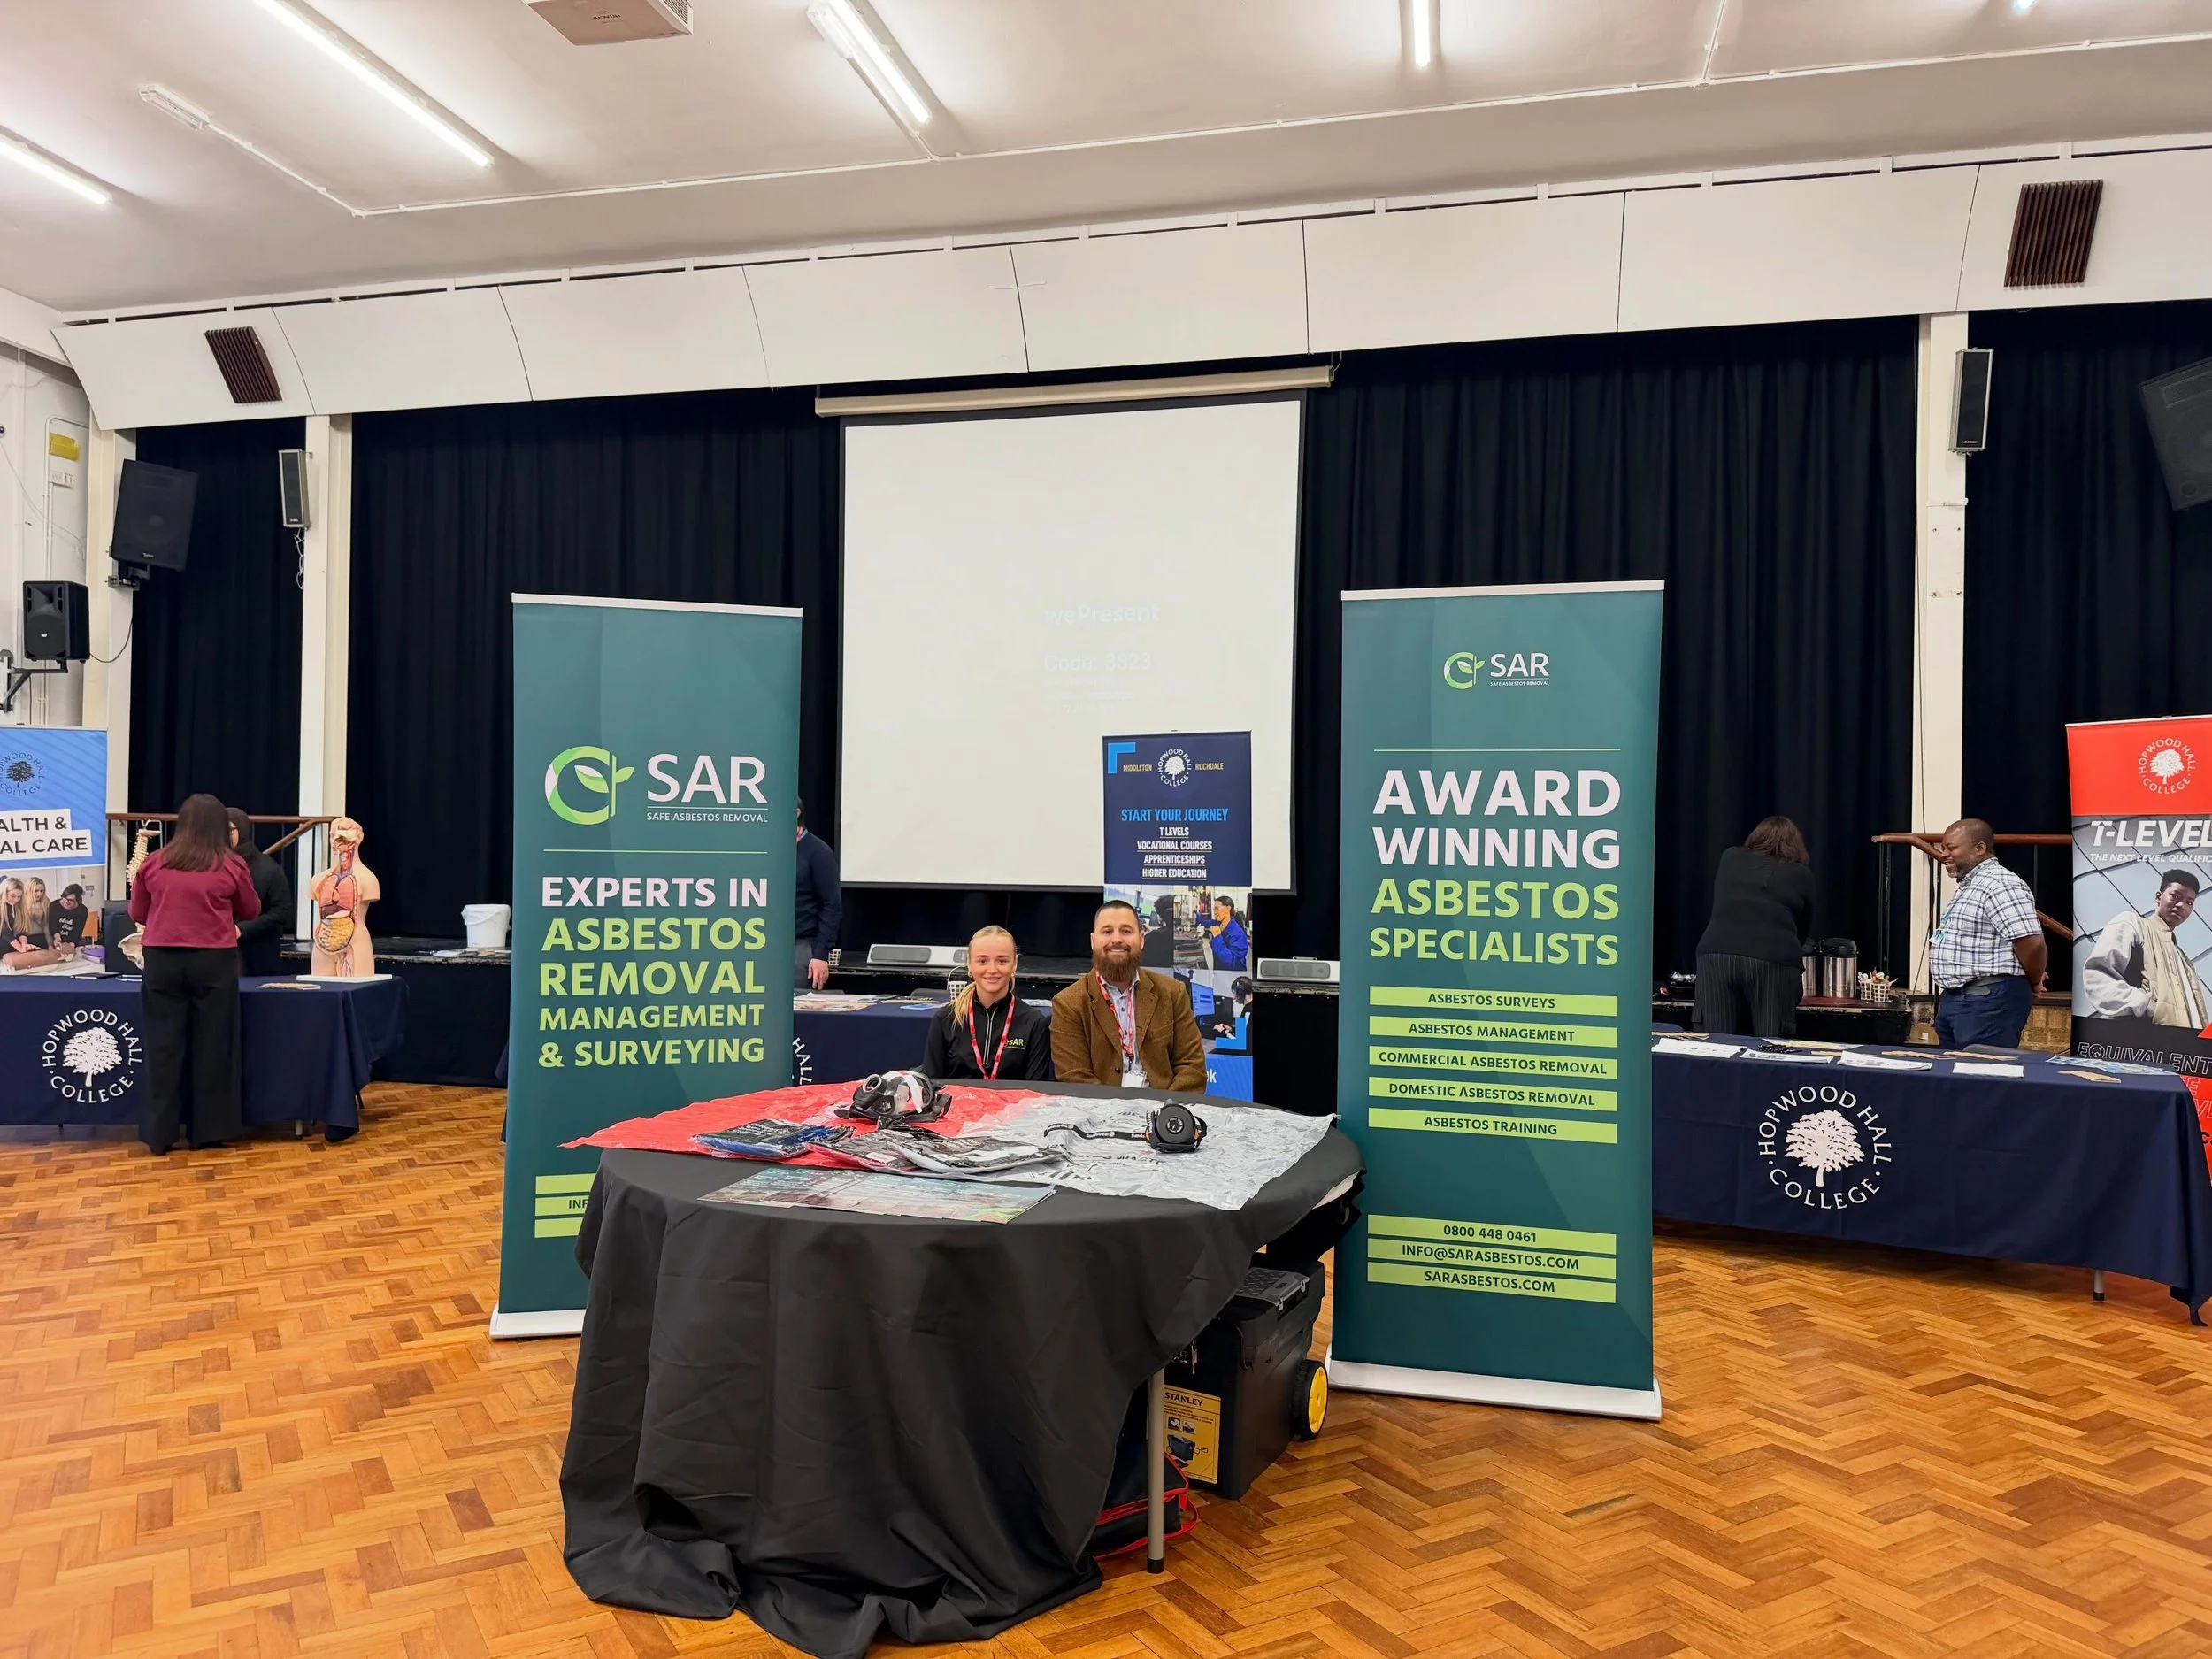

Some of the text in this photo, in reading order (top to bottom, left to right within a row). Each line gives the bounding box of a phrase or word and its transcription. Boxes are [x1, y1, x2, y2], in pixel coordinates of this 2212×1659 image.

[1044, 604, 1162, 625] wePresent
[1490, 652, 1550, 678] SAR
[1123, 762, 1225, 772] MIDDLETON ROCHDALE
[1157, 748, 1193, 773] HOPWOOD HALL
[2138, 738, 2196, 774] HOPWOOD HALL
[1, 783, 42, 796] COLLEGE
[647, 753, 768, 804] SAR
[1160, 772, 1189, 787] COLLEGE
[2142, 777, 2192, 795] COLLEGE
[1372, 770, 1621, 817] AWARD
[55, 816, 67, 830] &
[647, 812, 768, 823] SAFE ASBESTOS REMOVAL
[1121, 808, 1229, 821] START YOUR JOURNEY
[1159, 826, 1189, 836] T LEVELS
[32, 837, 88, 853] CARE
[1137, 841, 1213, 850] VOCATIONAL COURSES
[1372, 826, 1620, 870] WINNING
[1143, 855, 1206, 864] APPRENTICESHIPS
[2090, 853, 2109, 862] THE
[2109, 853, 2137, 862] NEXT
[2137, 854, 2166, 863] LEVEL
[1142, 868, 1207, 879] HIGHER EDUCATION
[541, 876, 768, 907] EXPERTS IN
[1371, 879, 1619, 921] ASBESTOS
[541, 917, 767, 952] ASBESTOS
[1370, 926, 1618, 966] SPECIALISTS
[539, 960, 765, 997] REMOVAL
[1428, 993, 1555, 1009] ASBESTOS SURVEYS
[538, 1003, 765, 1031] MANAGEMENT
[42, 1009, 142, 1068] HOPWOOD HALL
[1409, 1023, 1575, 1041] ASBESTOS MANAGEMENT
[538, 1037, 764, 1069] & SURVEYING
[792, 1037, 813, 1086] HALL
[1379, 1051, 1607, 1075] COMMERCIAL ASBESTOS REMOVAL
[50, 1075, 134, 1103] COLLEGE
[1389, 1083, 1595, 1106] DOMESTIC ASBESTOS REMOVAL
[1424, 1117, 1558, 1135] ASBESTOS TRAINING
[1758, 1086, 1892, 1165] HOPWOOD HALL
[1770, 1168, 1880, 1210] COLLEGE
[1443, 1225, 1537, 1243] 0800 448 0461
[1402, 1244, 1579, 1270] INFO@SARASBESTOS.COM
[1425, 1271, 1555, 1293] SARASBESTOS.COM
[1164, 1392, 1204, 1407] STANLEY
